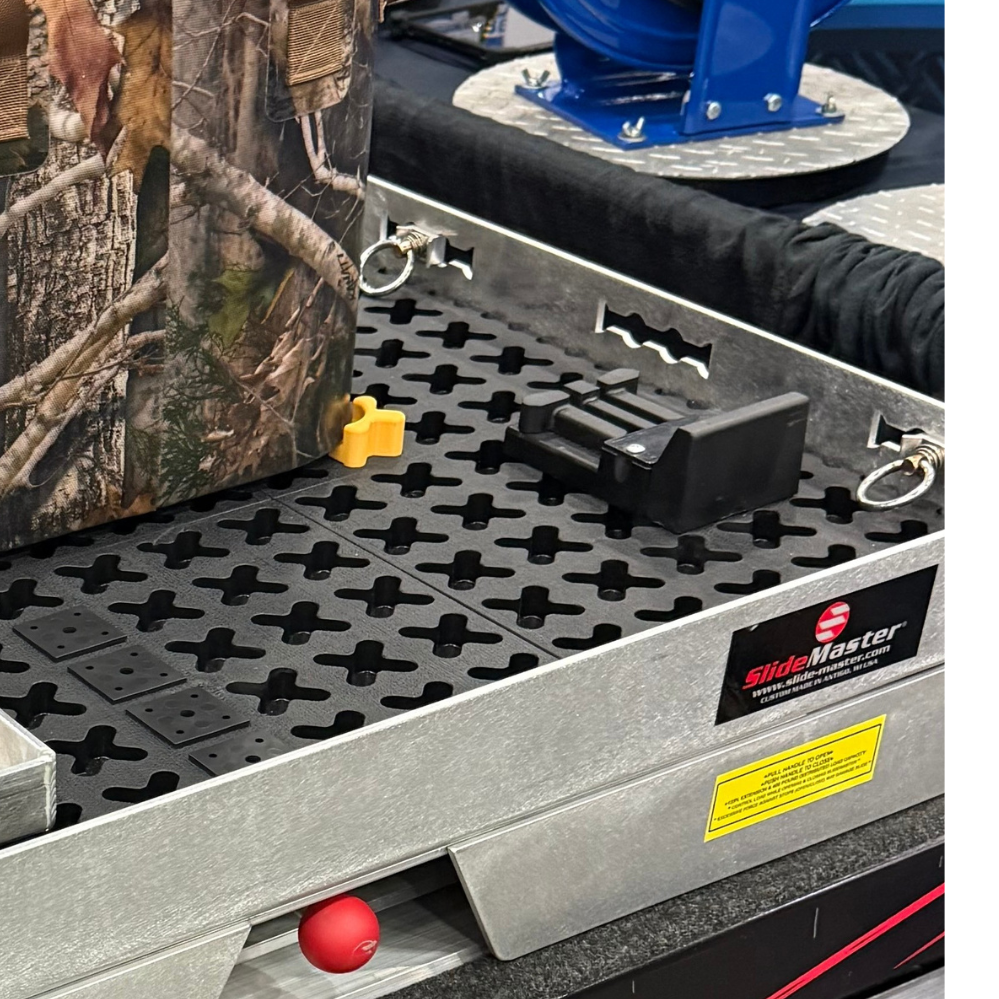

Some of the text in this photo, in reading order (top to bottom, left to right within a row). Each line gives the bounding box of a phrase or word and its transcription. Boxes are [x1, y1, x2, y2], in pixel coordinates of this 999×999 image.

[752, 644, 891, 698] www.slide-master.com
[760, 689, 791, 704] CUSTOM
[792, 681, 814, 694] MADE
[814, 678, 822, 687] IN
[862, 658, 878, 670] USA
